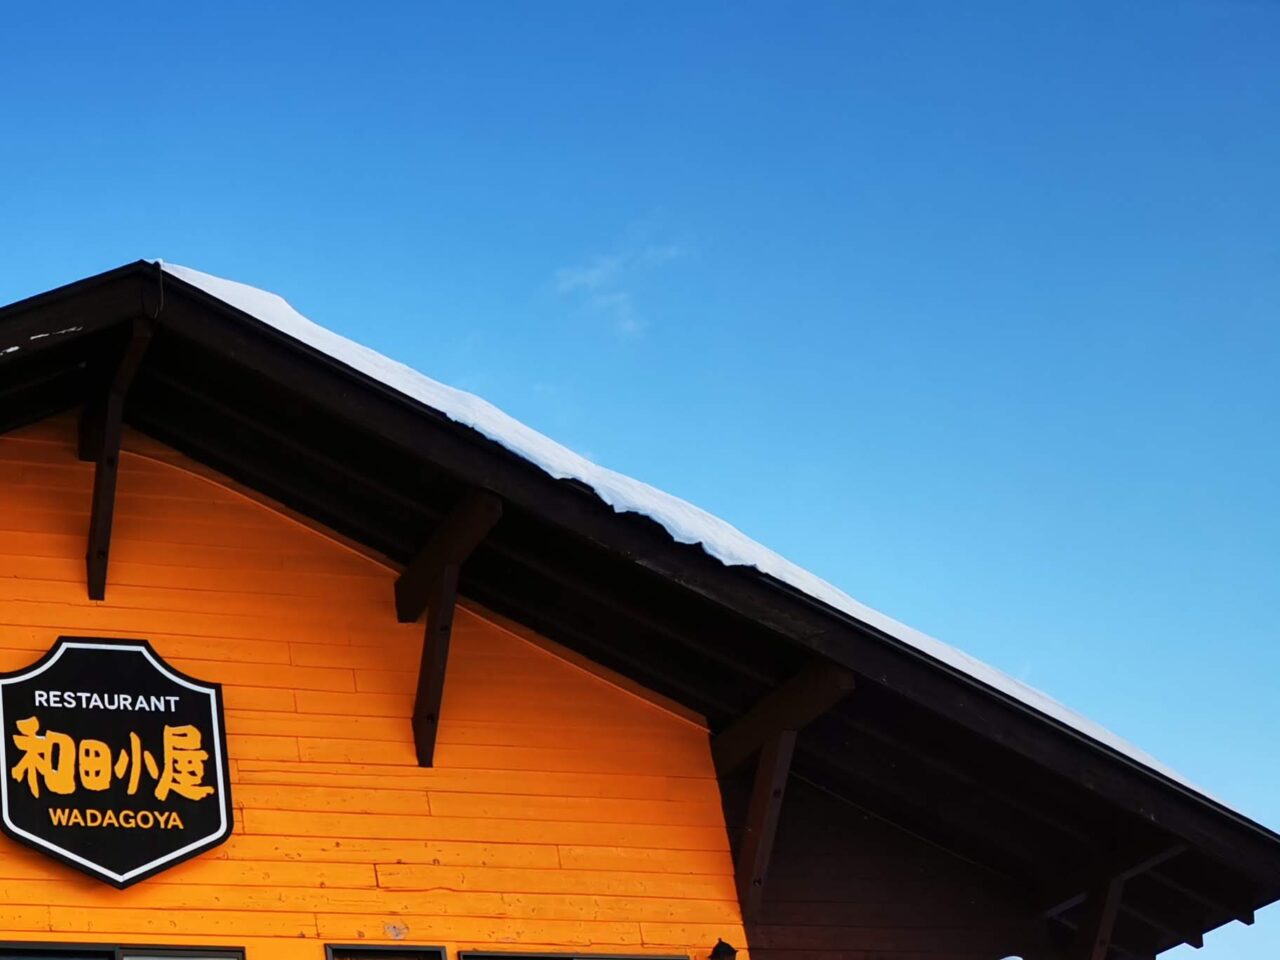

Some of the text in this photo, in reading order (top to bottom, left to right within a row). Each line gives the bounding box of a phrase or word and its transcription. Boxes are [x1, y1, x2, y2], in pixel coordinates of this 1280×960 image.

[35, 690, 180, 713] RESTAURANT
[11, 715, 215, 802] 和田小屋
[48, 807, 184, 830] WADAGOYA
